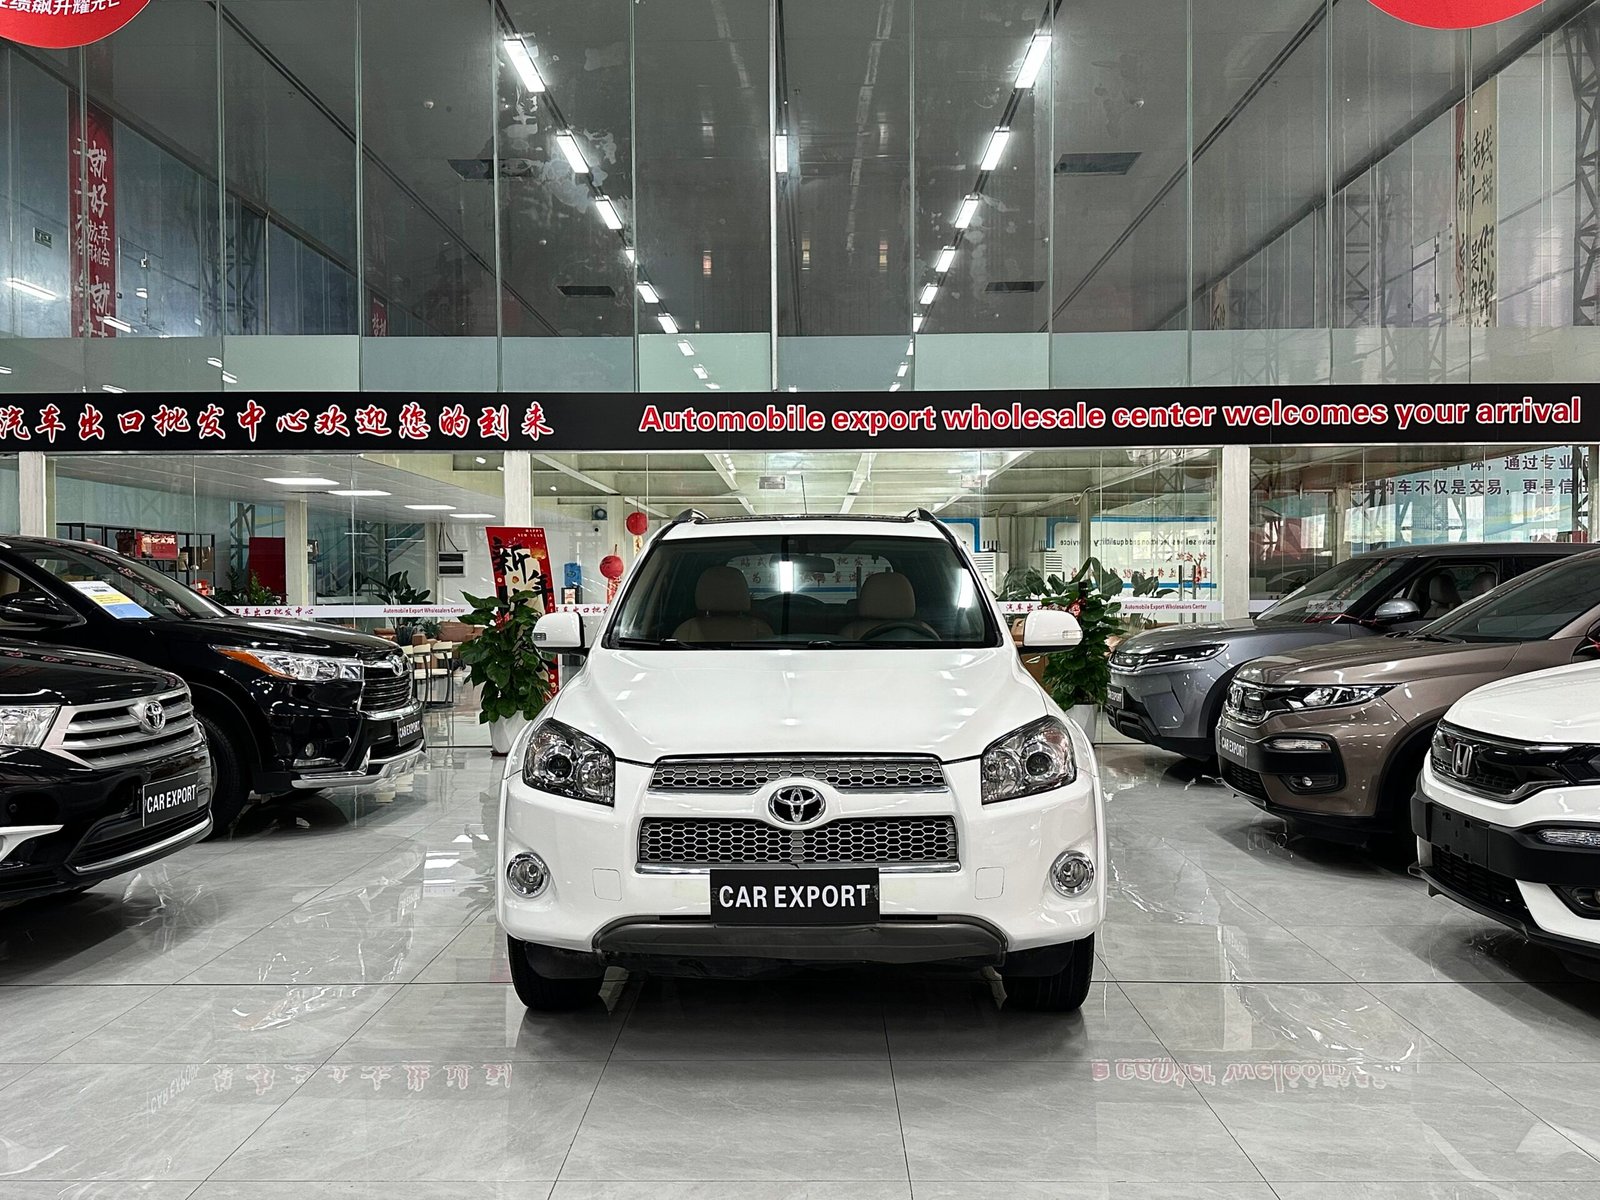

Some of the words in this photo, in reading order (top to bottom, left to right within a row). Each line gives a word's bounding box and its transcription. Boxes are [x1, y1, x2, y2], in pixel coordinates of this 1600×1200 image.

[0, 400, 554, 443] 汽车出口批发中心欢迎您的到来
[639, 404, 826, 432] Automobile
[832, 406, 937, 436] export
[941, 402, 1106, 430] wholesale
[1112, 402, 1218, 428] center
[1222, 398, 1389, 427] welcomes
[1394, 404, 1471, 430] your
[1476, 396, 1581, 425] arrival
[1150, 603, 1165, 611] Export
[1229, 739, 1245, 758] EXPORT
[147, 793, 165, 813] CAR
[166, 784, 197, 808] EXPORT
[719, 884, 768, 908] CAR
[774, 884, 871, 908] EXPORT
